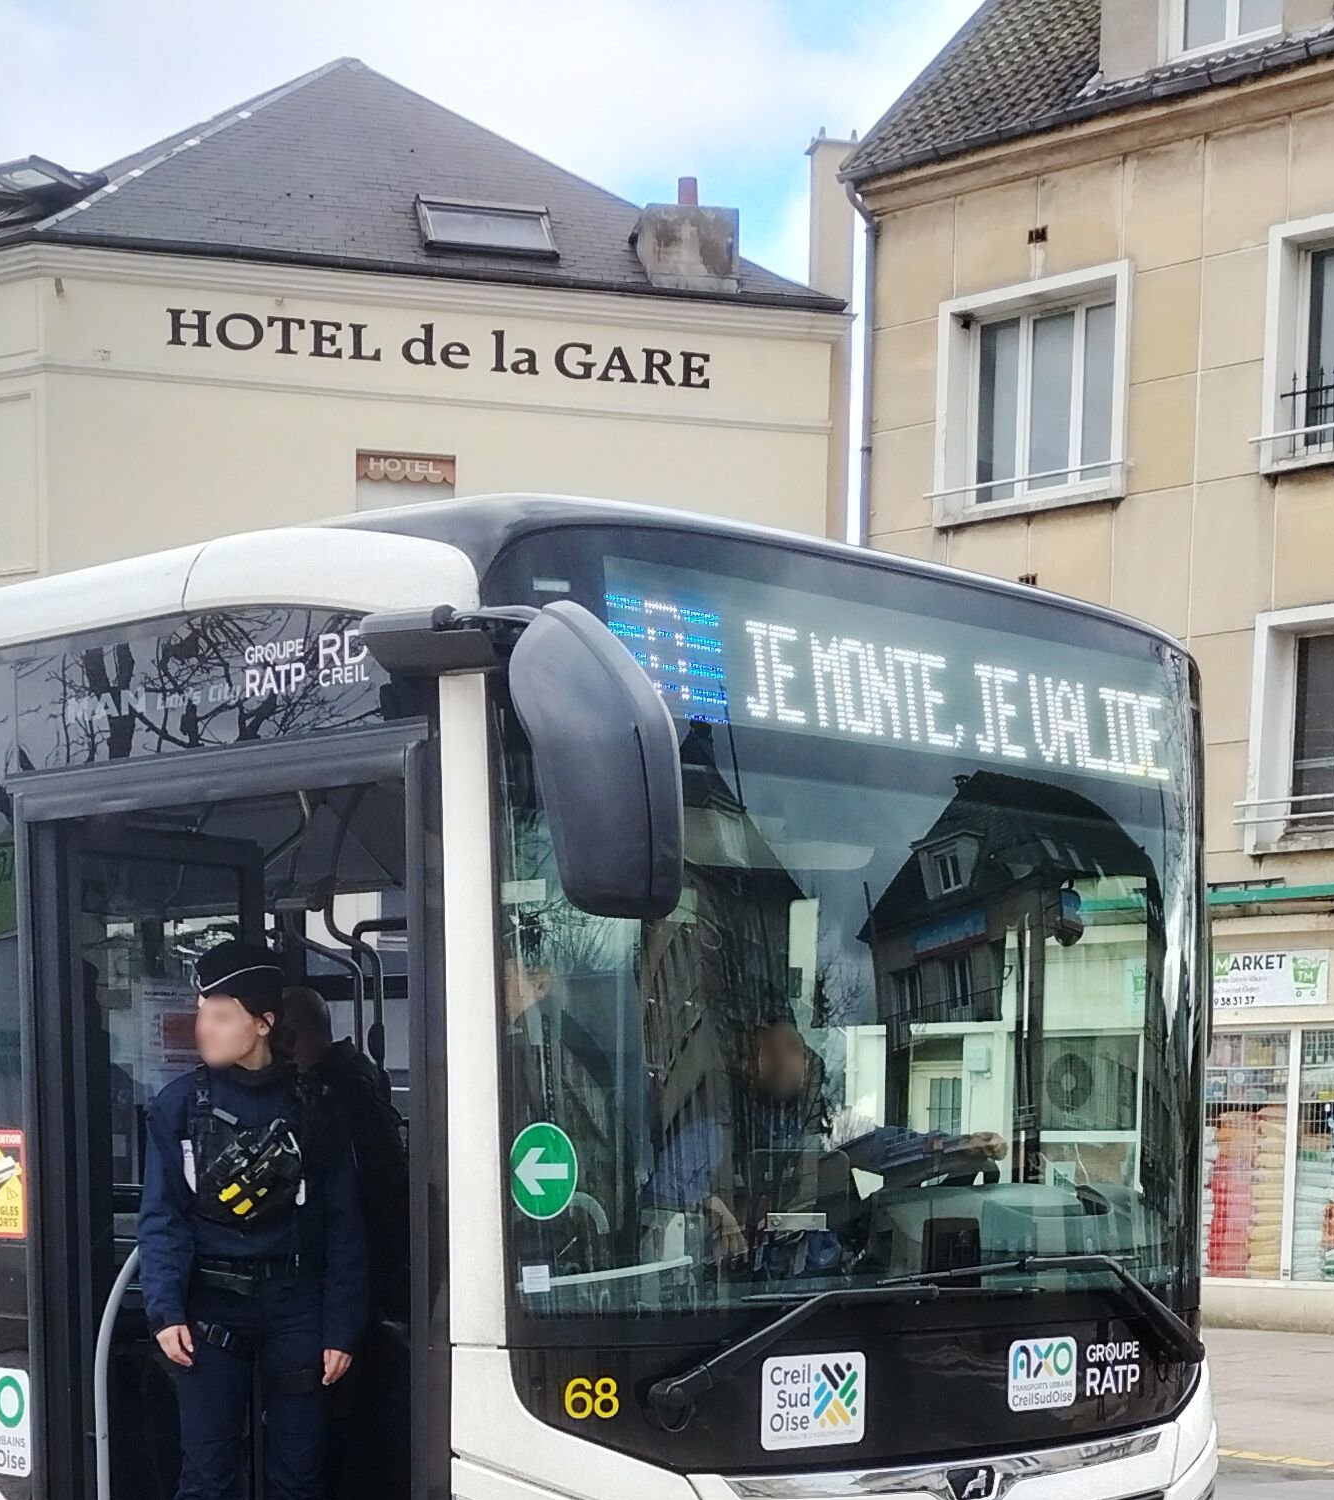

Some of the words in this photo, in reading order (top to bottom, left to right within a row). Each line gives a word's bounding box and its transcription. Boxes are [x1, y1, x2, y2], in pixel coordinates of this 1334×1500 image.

[166, 308, 381, 362] HOTEL
[402, 323, 471, 369] de
[491, 330, 539, 375] la
[554, 341, 711, 389] GARE
[369, 456, 442, 475] HOTEL
[244, 638, 305, 664] GROUPE
[245, 662, 306, 698] RATP
[319, 669, 370, 687] CREIL
[745, 619, 806, 724] JE
[974, 663, 1027, 758] JE
[67, 688, 147, 722] MAN
[1215, 954, 1287, 973] MARKET
[1297, 970, 1314, 981] TM
[1013, 1342, 1074, 1380] AXO
[1086, 1341, 1140, 1362] GROUPE
[770, 1363, 812, 1387] Creil
[1086, 1364, 1140, 1396] RATP
[563, 1378, 620, 1420] 68
[776, 1387, 811, 1409] Sud
[1011, 1389, 1073, 1407] CreilSudOise
[770, 1410, 810, 1433] Oise
